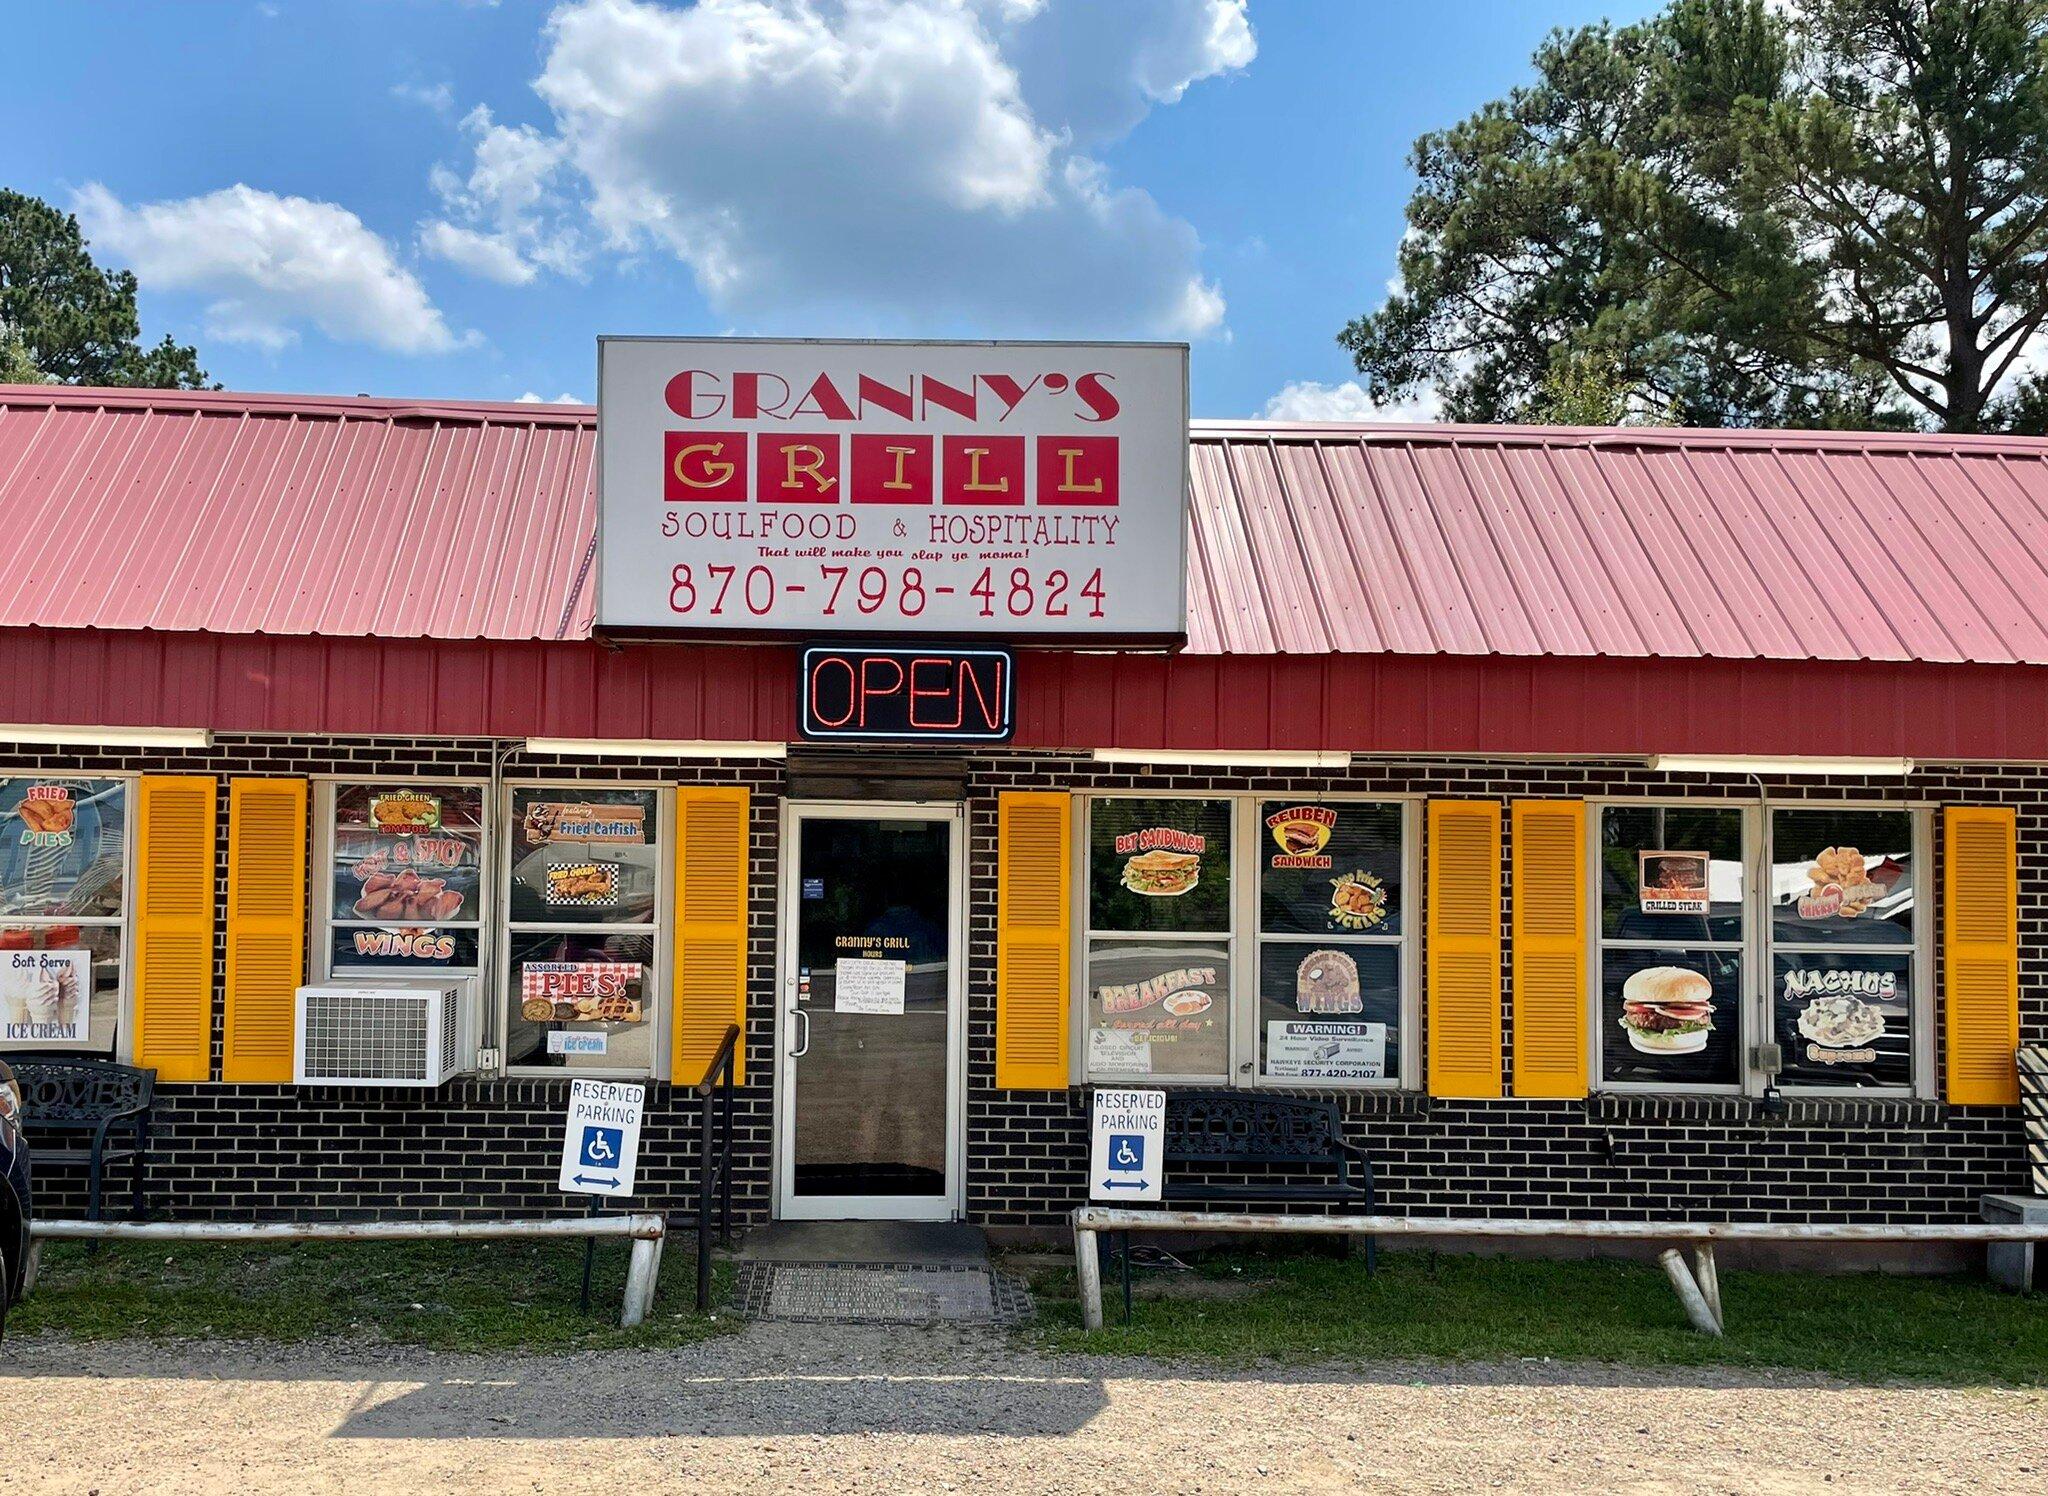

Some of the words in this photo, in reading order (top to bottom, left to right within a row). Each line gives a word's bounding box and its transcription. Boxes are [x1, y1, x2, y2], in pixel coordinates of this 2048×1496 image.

[664, 369, 1120, 422] GRANNY'S
[672, 441, 1104, 493] GRILL
[662, 510, 857, 540] SOULFOOD
[892, 517, 908, 538] &
[928, 513, 1120, 546] HOSPITALITY
[758, 545, 789, 558] That
[794, 547, 827, 558] will
[831, 547, 873, 558] make
[876, 549, 904, 561] you
[911, 549, 943, 561] slap
[951, 551, 969, 562] yo
[978, 548, 1030, 560] moma!
[668, 563, 1106, 618] 870-798-4824
[812, 657, 1001, 729] OPEN
[28, 787, 69, 801] FRIED
[380, 794, 403, 802] FRIED
[404, 794, 431, 802] GREEN
[1266, 806, 1337, 828] REUBEN
[379, 824, 430, 834] TOMATOES
[560, 822, 593, 835] Fried
[594, 822, 638, 836] Catfish
[20, 831, 72, 846] PIES
[1116, 833, 1139, 853] BLT
[1140, 828, 1205, 852] SANDWICH
[412, 838, 467, 868] SPICY
[1273, 855, 1332, 868] SANDWICH
[1646, 901, 1677, 911] GRILLED
[1678, 901, 1703, 911] STEAK
[354, 931, 456, 959] WINGS
[12, 954, 36, 968] Soft
[40, 954, 71, 968] Serve
[524, 963, 579, 973] ASSORTED
[542, 973, 627, 998] PIES!
[1099, 967, 1216, 1013] BREAKFAST
[1784, 969, 1897, 1000] NACHOS
[6, 1023, 28, 1039] ICE
[31, 1023, 77, 1039] CREAM
[1293, 1025, 1361, 1035] WARNING!
[1301, 1069, 1376, 1078] 877-420-2107
[572, 1082, 643, 1103] RESERVED
[1096, 1093, 1164, 1109] RESERVED
[576, 1104, 635, 1124] PARKING
[1101, 1114, 1158, 1130] PARKING
